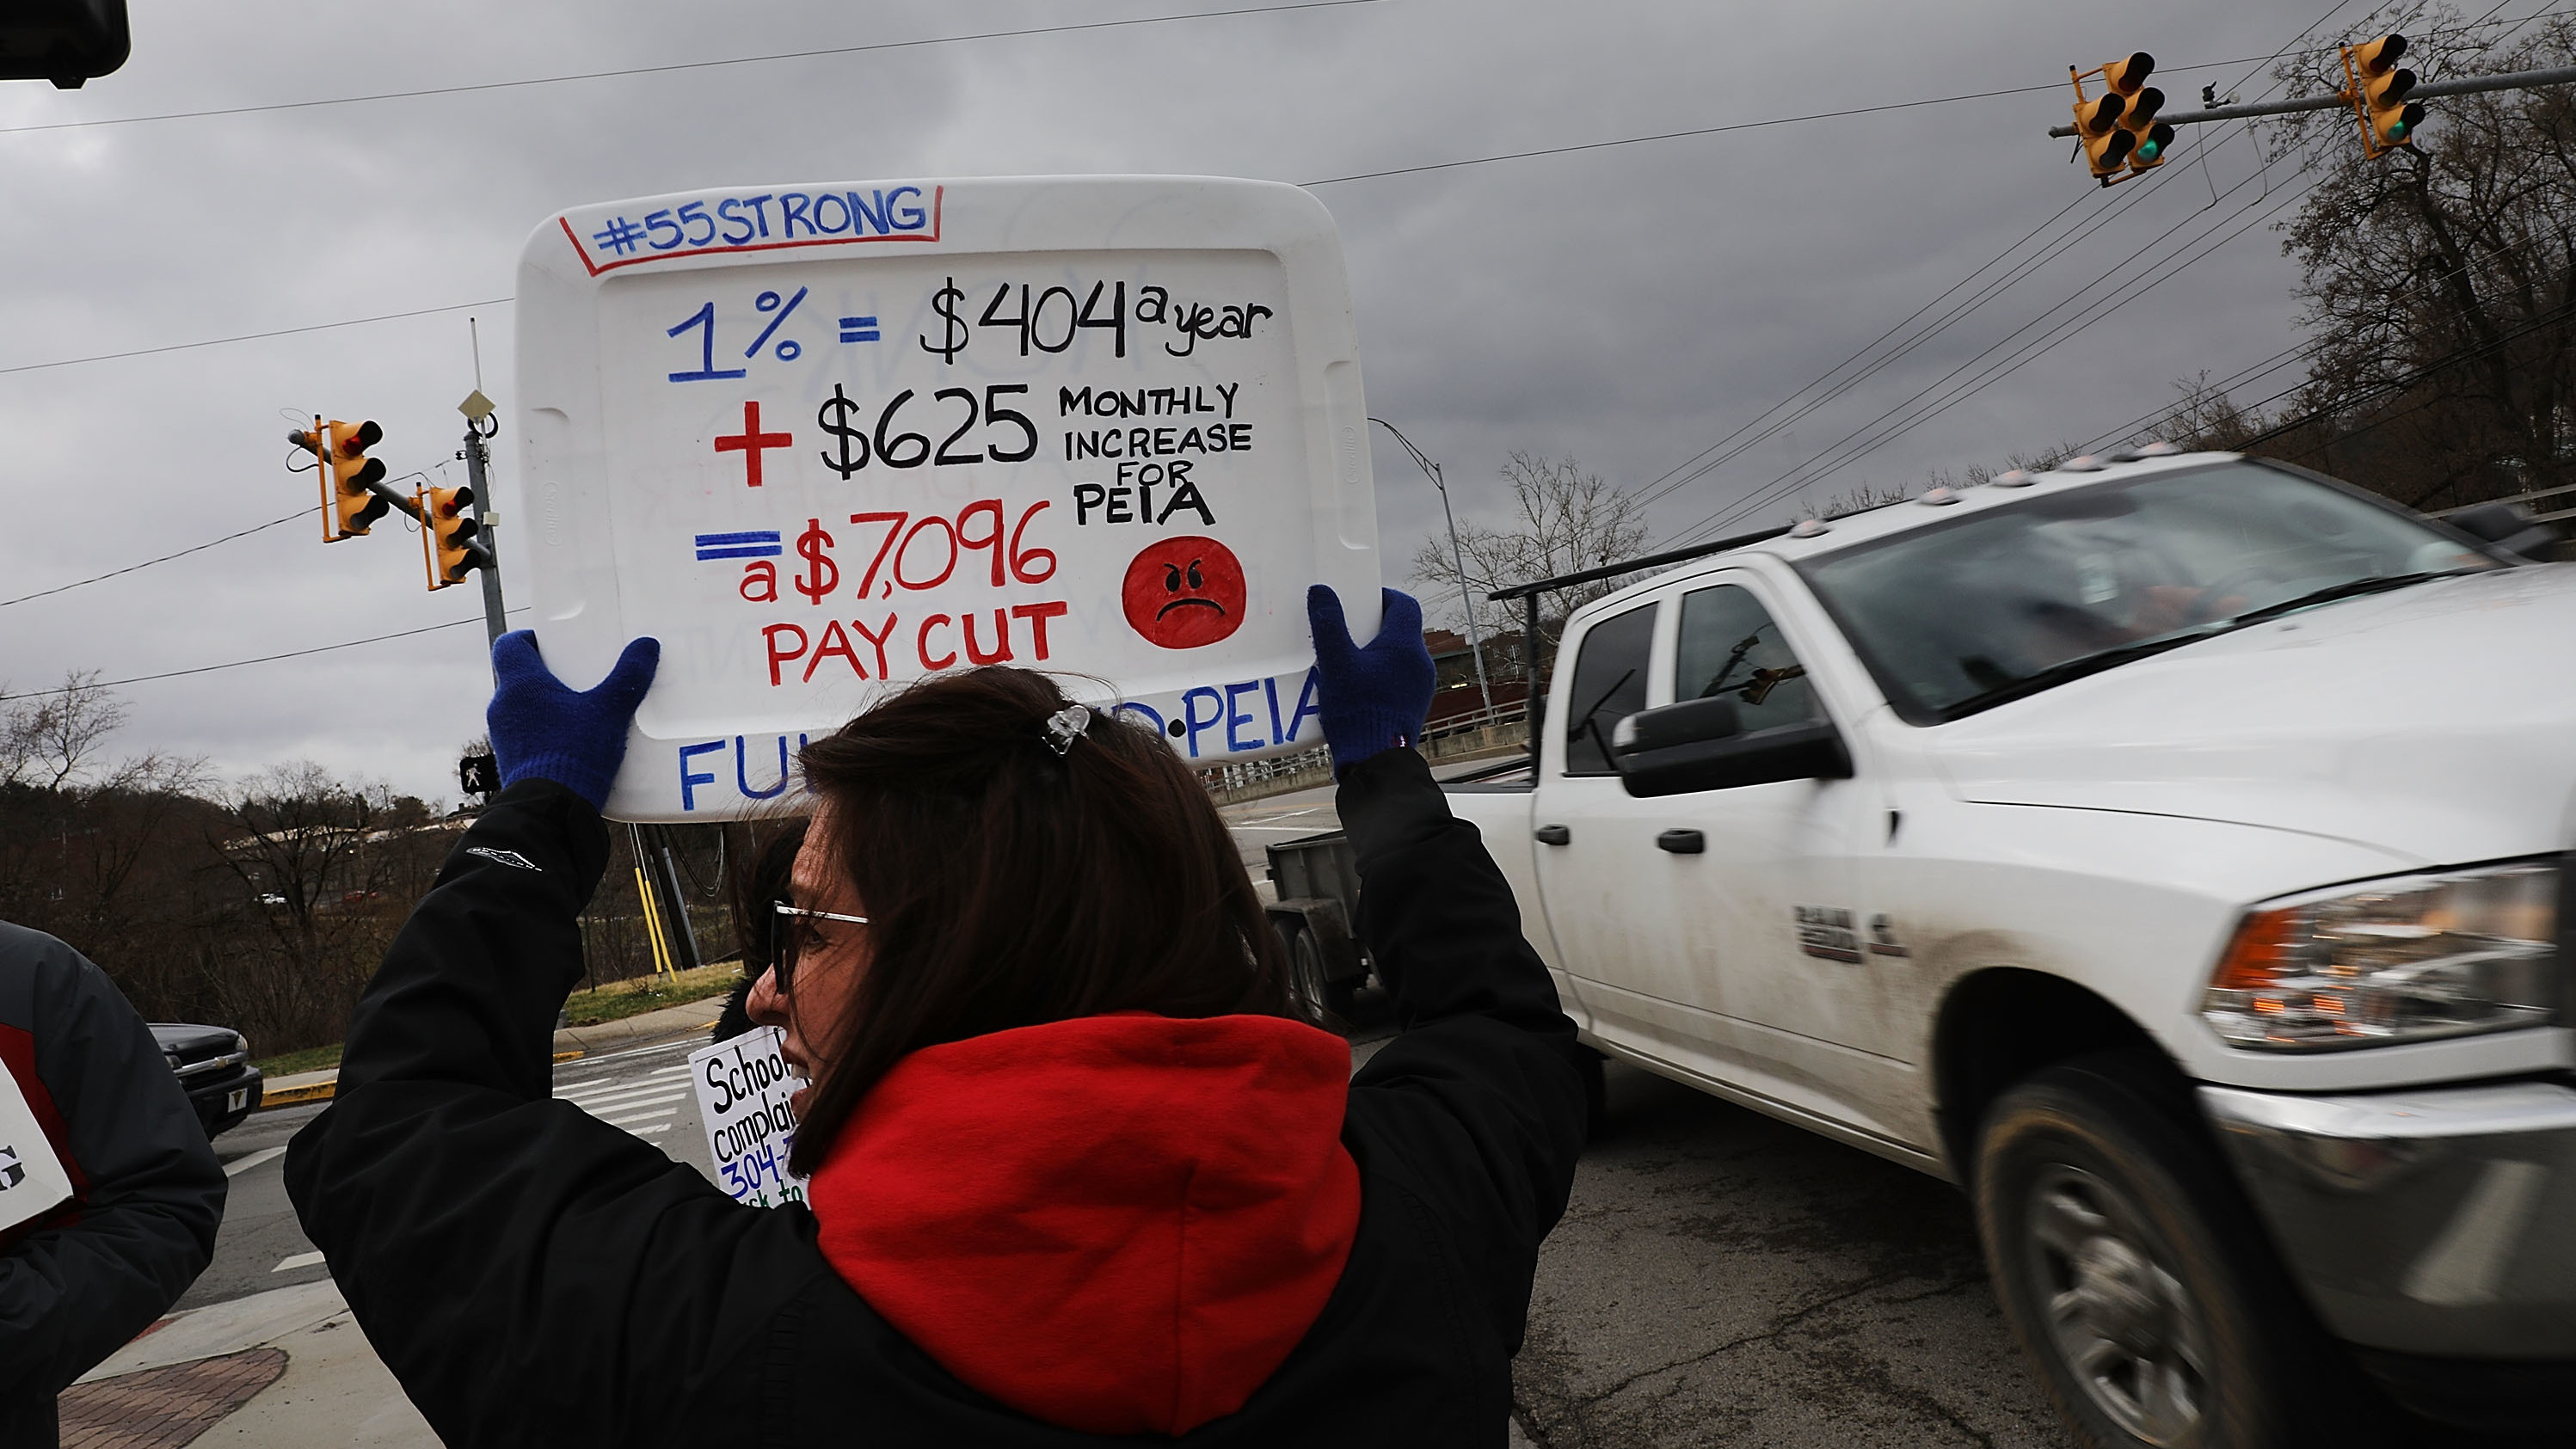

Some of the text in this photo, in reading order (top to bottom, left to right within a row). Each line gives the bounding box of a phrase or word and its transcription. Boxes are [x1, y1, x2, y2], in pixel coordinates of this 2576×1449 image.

[593, 186, 927, 256] #55STRONG
[667, 286, 808, 384] 1%
[919, 276, 1126, 365] $404
[1135, 285, 1169, 325] a
[1165, 299, 1274, 357] year
[818, 383, 1038, 482] $625
[1059, 382, 1239, 419] MONTHLY
[1065, 423, 1253, 461] INCREASE
[1116, 459, 1194, 488] FOR
[1073, 481, 1216, 526] PEIA
[739, 560, 778, 603] a
[794, 498, 1058, 605] $7,096
[761, 600, 1068, 687] PAY CUT
[714, 1091, 796, 1163] complai
[721, 1135, 795, 1199] 304-
[778, 1179, 803, 1204] to
